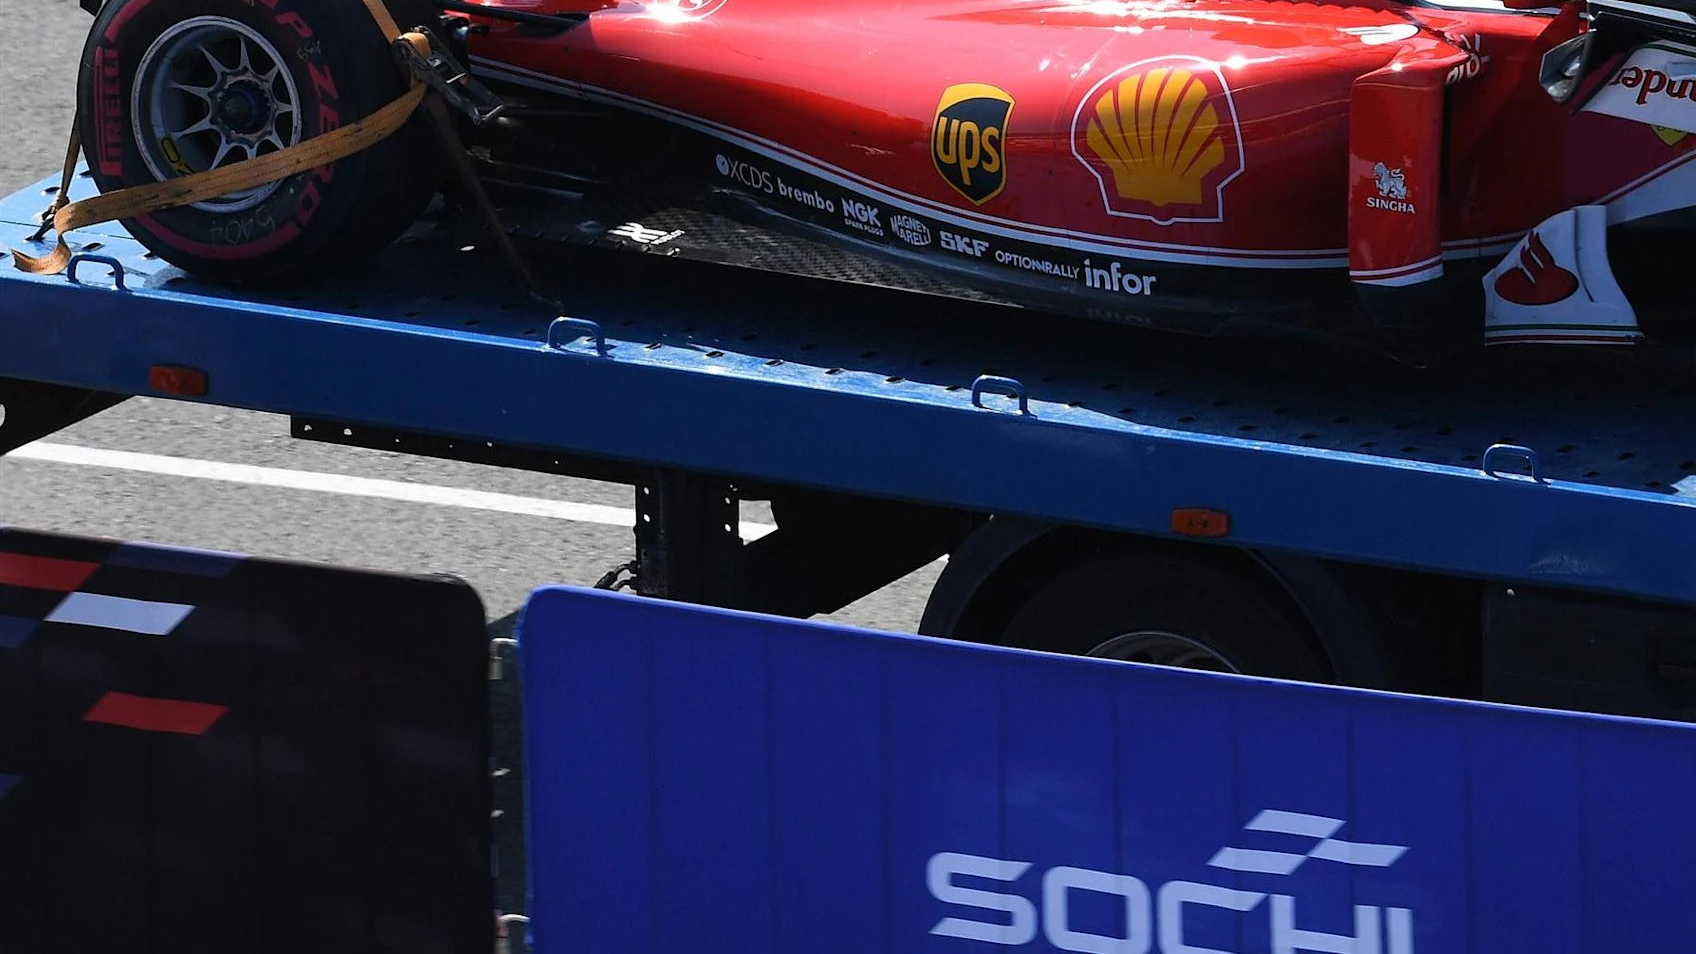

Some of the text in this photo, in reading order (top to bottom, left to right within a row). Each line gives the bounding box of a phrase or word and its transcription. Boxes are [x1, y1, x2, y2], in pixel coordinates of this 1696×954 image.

[936, 115, 1001, 187] ups
[777, 176, 835, 213] brembo
[841, 197, 882, 227] NGK
[1366, 196, 1417, 215] SINGHA
[939, 230, 989, 258] SKF
[1083, 257, 1157, 297] infor
[924, 851, 1414, 954] SOCHI
